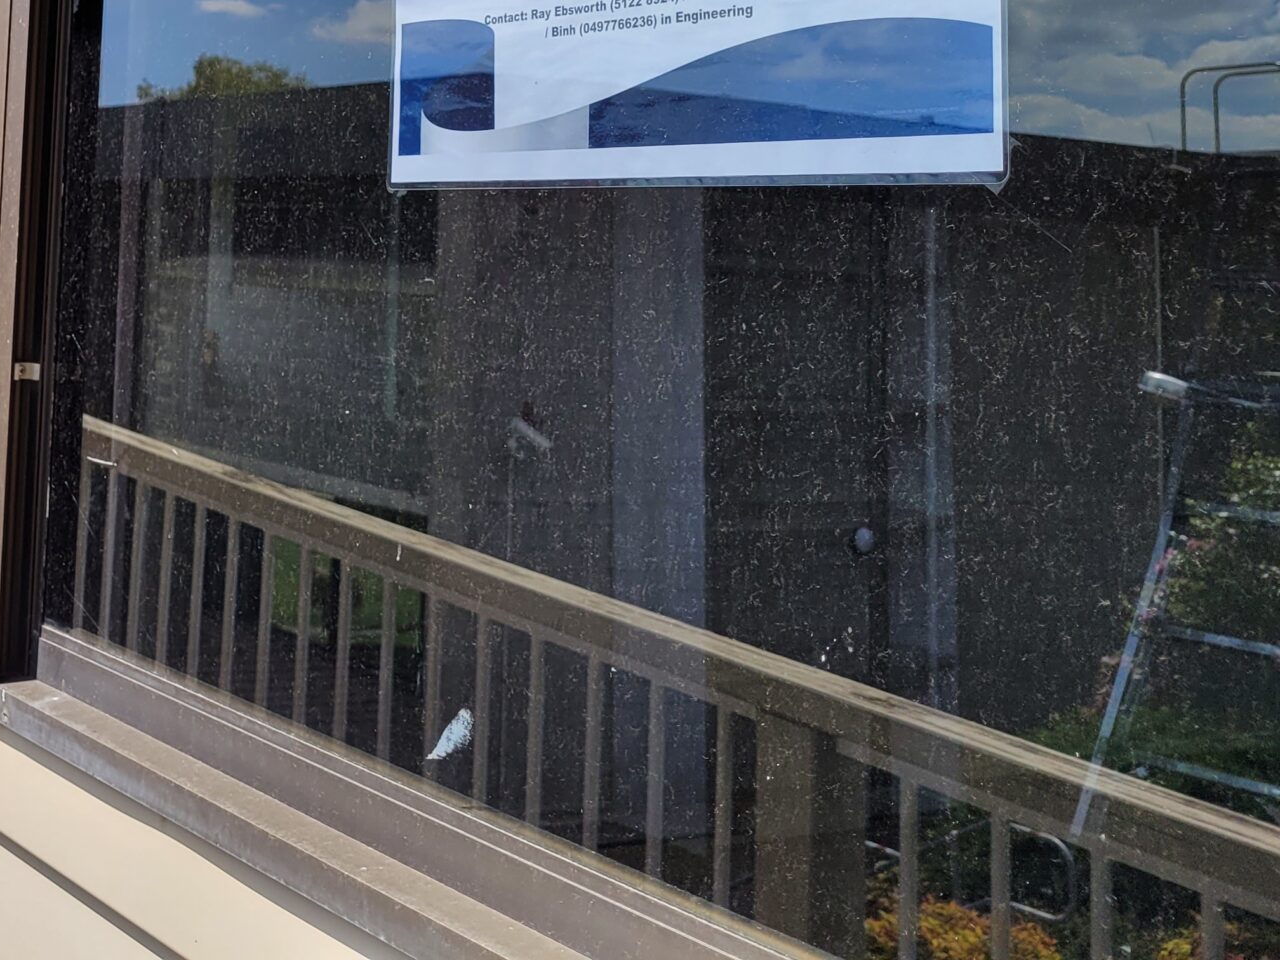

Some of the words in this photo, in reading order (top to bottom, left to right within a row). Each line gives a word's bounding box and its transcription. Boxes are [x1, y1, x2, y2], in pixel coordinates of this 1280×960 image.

[484, 10, 528, 25] Contact:
[531, 9, 551, 21] Ray
[554, 0, 607, 17] Ebsworth
[552, 24, 576, 38] Binh
[579, 14, 657, 37] (0497766236)
[661, 13, 672, 25] in
[676, 5, 753, 25] Engineering
